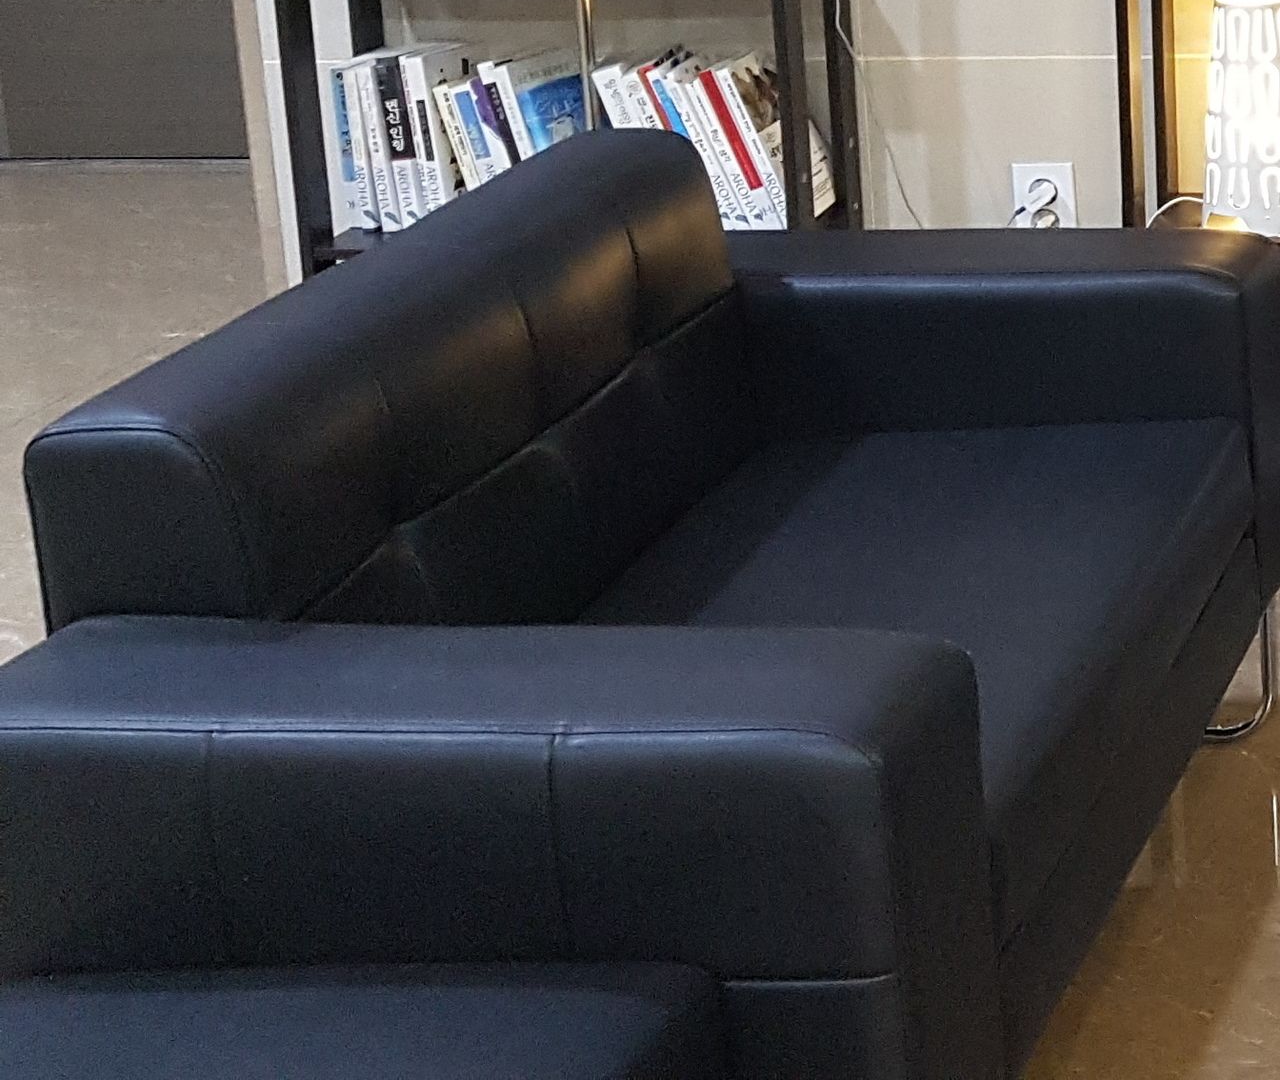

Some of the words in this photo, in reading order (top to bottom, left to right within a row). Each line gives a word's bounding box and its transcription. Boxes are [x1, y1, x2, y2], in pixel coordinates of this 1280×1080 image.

[374, 166, 390, 209] AROHA
[396, 166, 413, 208] AROHA
[712, 173, 737, 214] AROHA
[731, 172, 756, 218] AROHA
